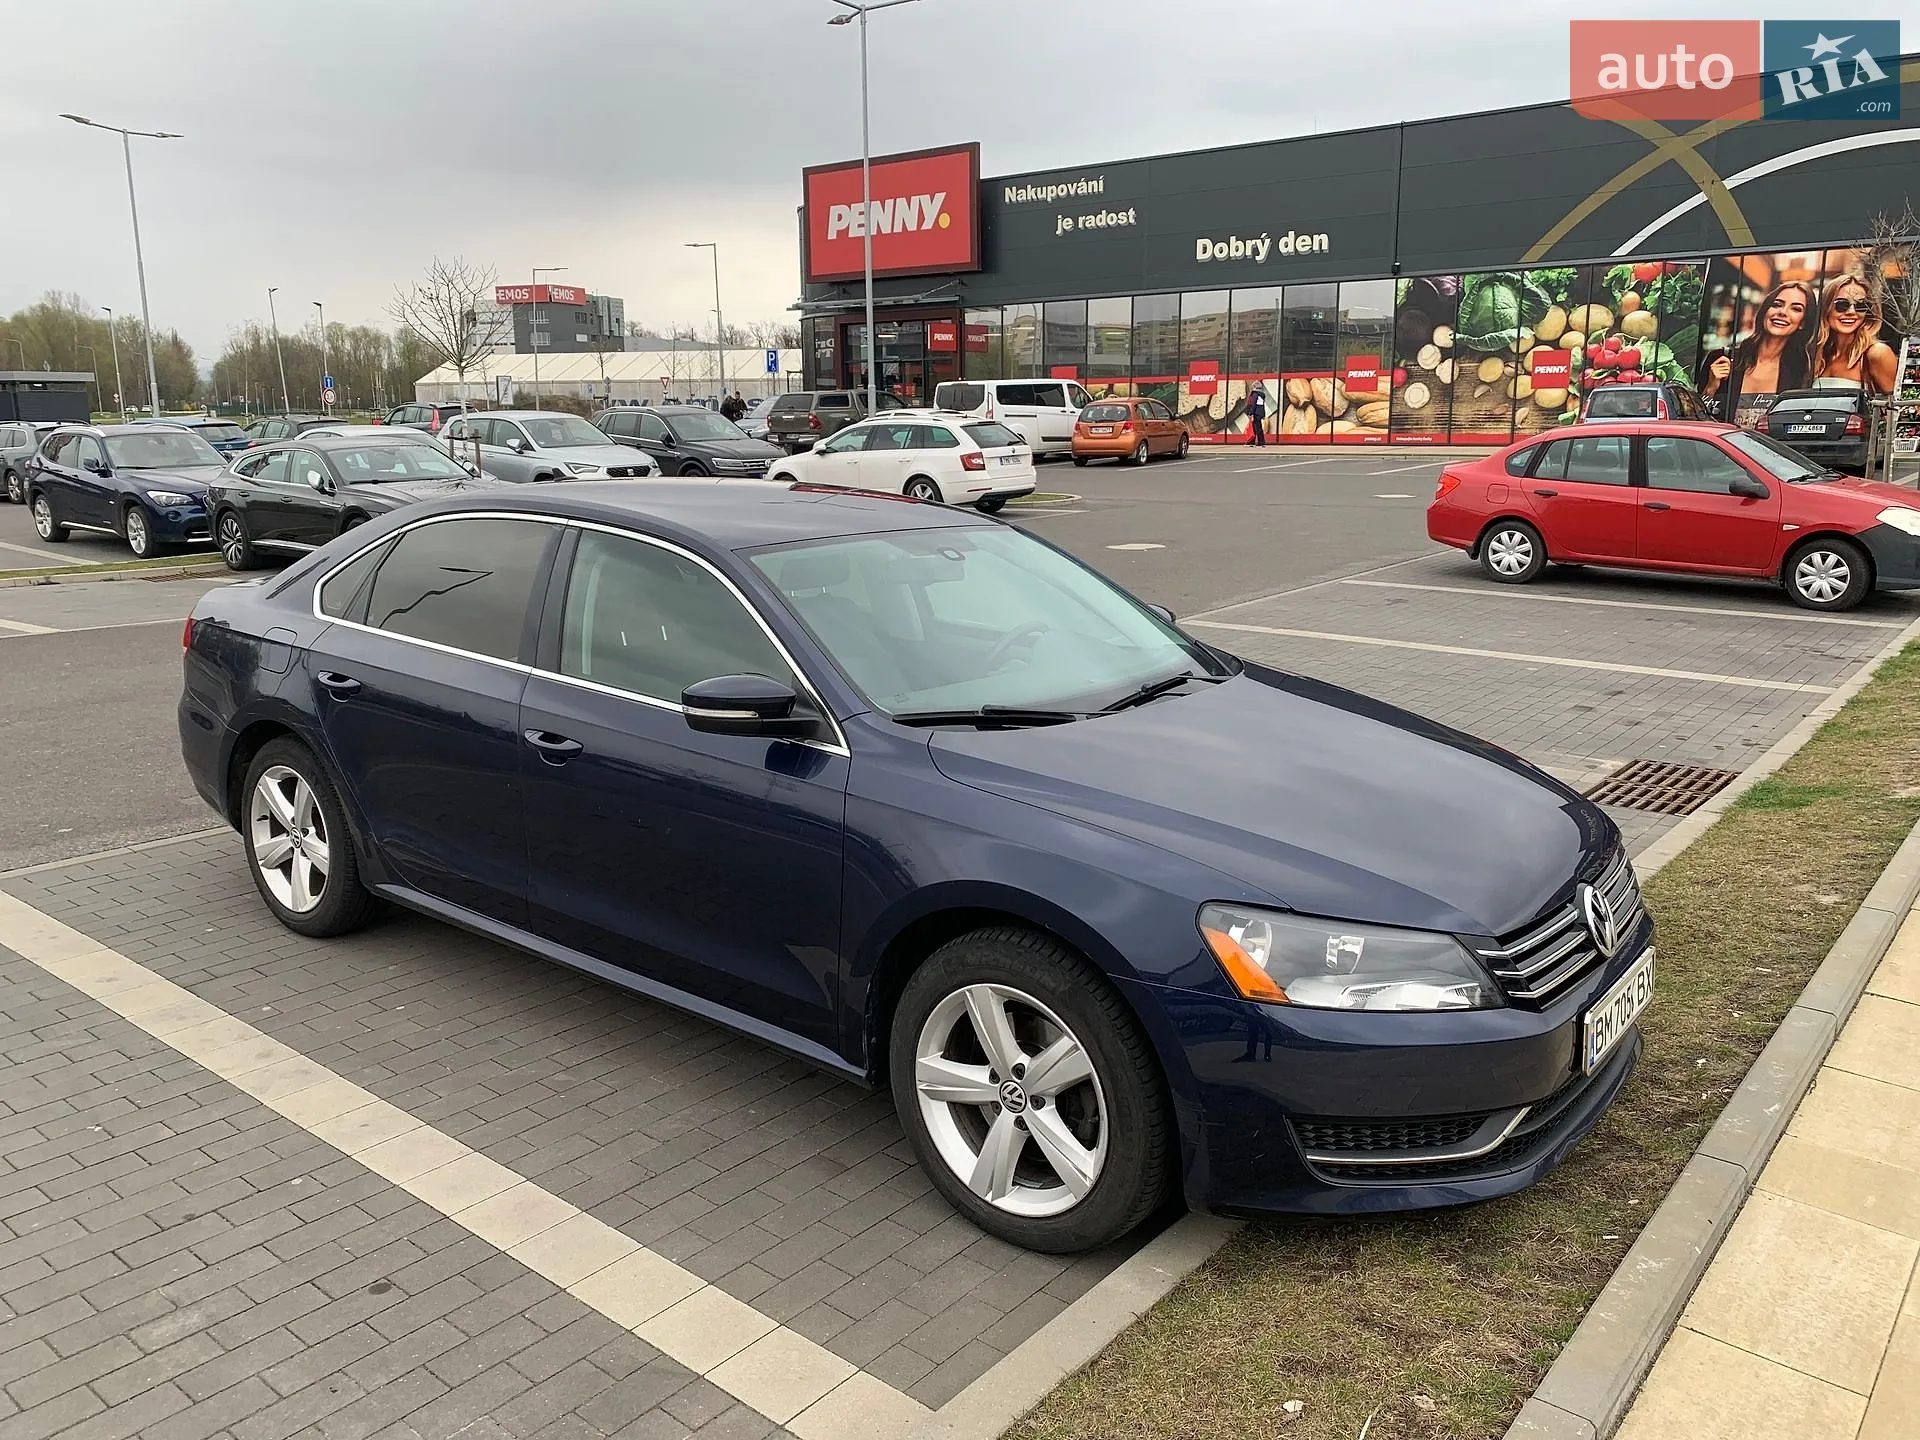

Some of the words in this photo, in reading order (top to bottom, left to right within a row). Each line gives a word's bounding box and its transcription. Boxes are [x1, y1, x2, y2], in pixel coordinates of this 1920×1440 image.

[1004, 175, 1104, 203] Nakupování
[1056, 214, 1075, 235] je
[1078, 207, 1137, 230] radost
[1196, 232, 1271, 263] Dobrý
[1278, 230, 1330, 256] den
[497, 288, 529, 301] EMOS
[554, 287, 575, 301] EMOS
[768, 352, 776, 366] P
[1595, 1005, 1613, 1055] BM
[1637, 962, 1653, 1007] BX
